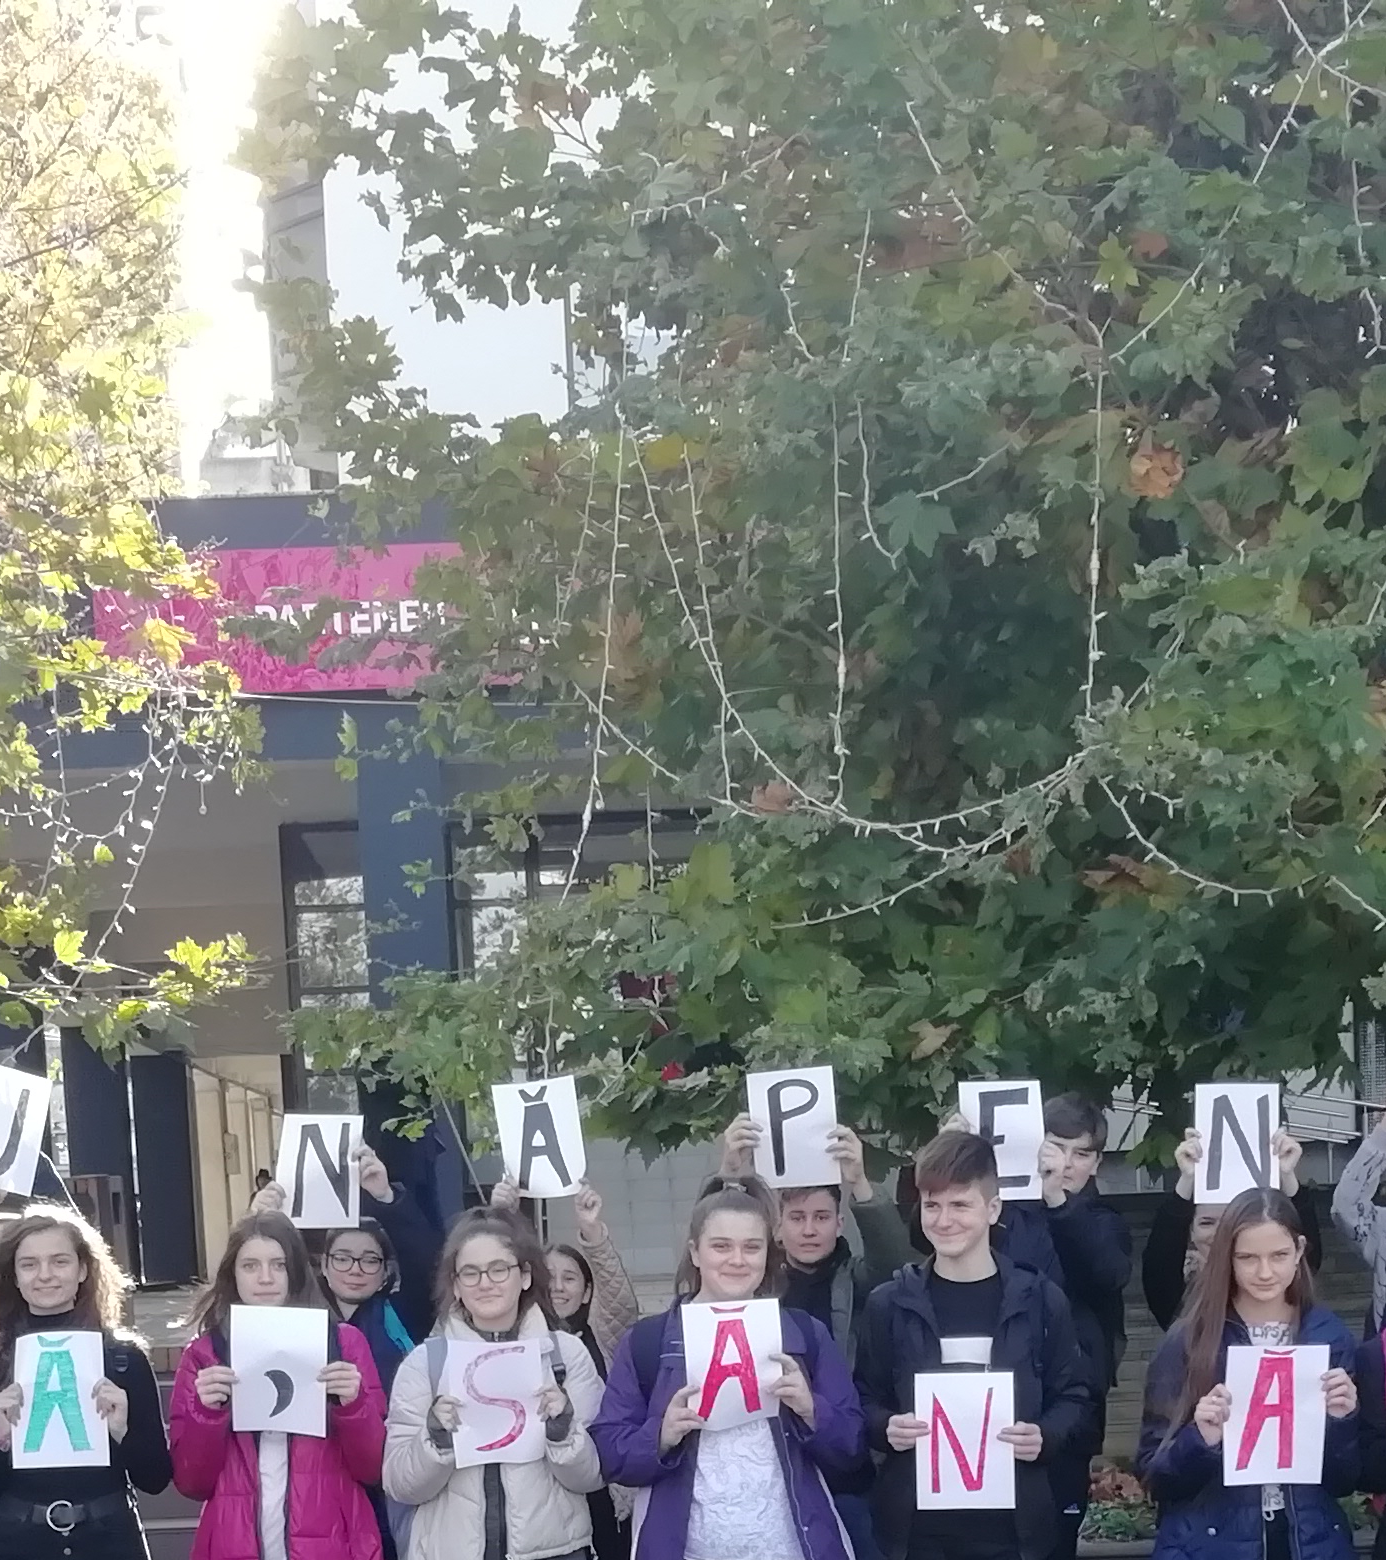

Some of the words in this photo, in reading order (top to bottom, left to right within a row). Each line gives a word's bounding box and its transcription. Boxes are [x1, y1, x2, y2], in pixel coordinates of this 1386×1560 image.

[290, 1122, 351, 1218] N
[518, 1085, 572, 1189] Ă
[767, 1078, 819, 1177] P
[979, 1087, 1031, 1188] E
[1207, 1093, 1271, 1191] N
[23, 1333, 94, 1454] Ă
[463, 1345, 527, 1452] S
[696, 1305, 763, 1422] Ă
[1235, 1348, 1297, 1471] Ă
[930, 1387, 994, 1494] N
